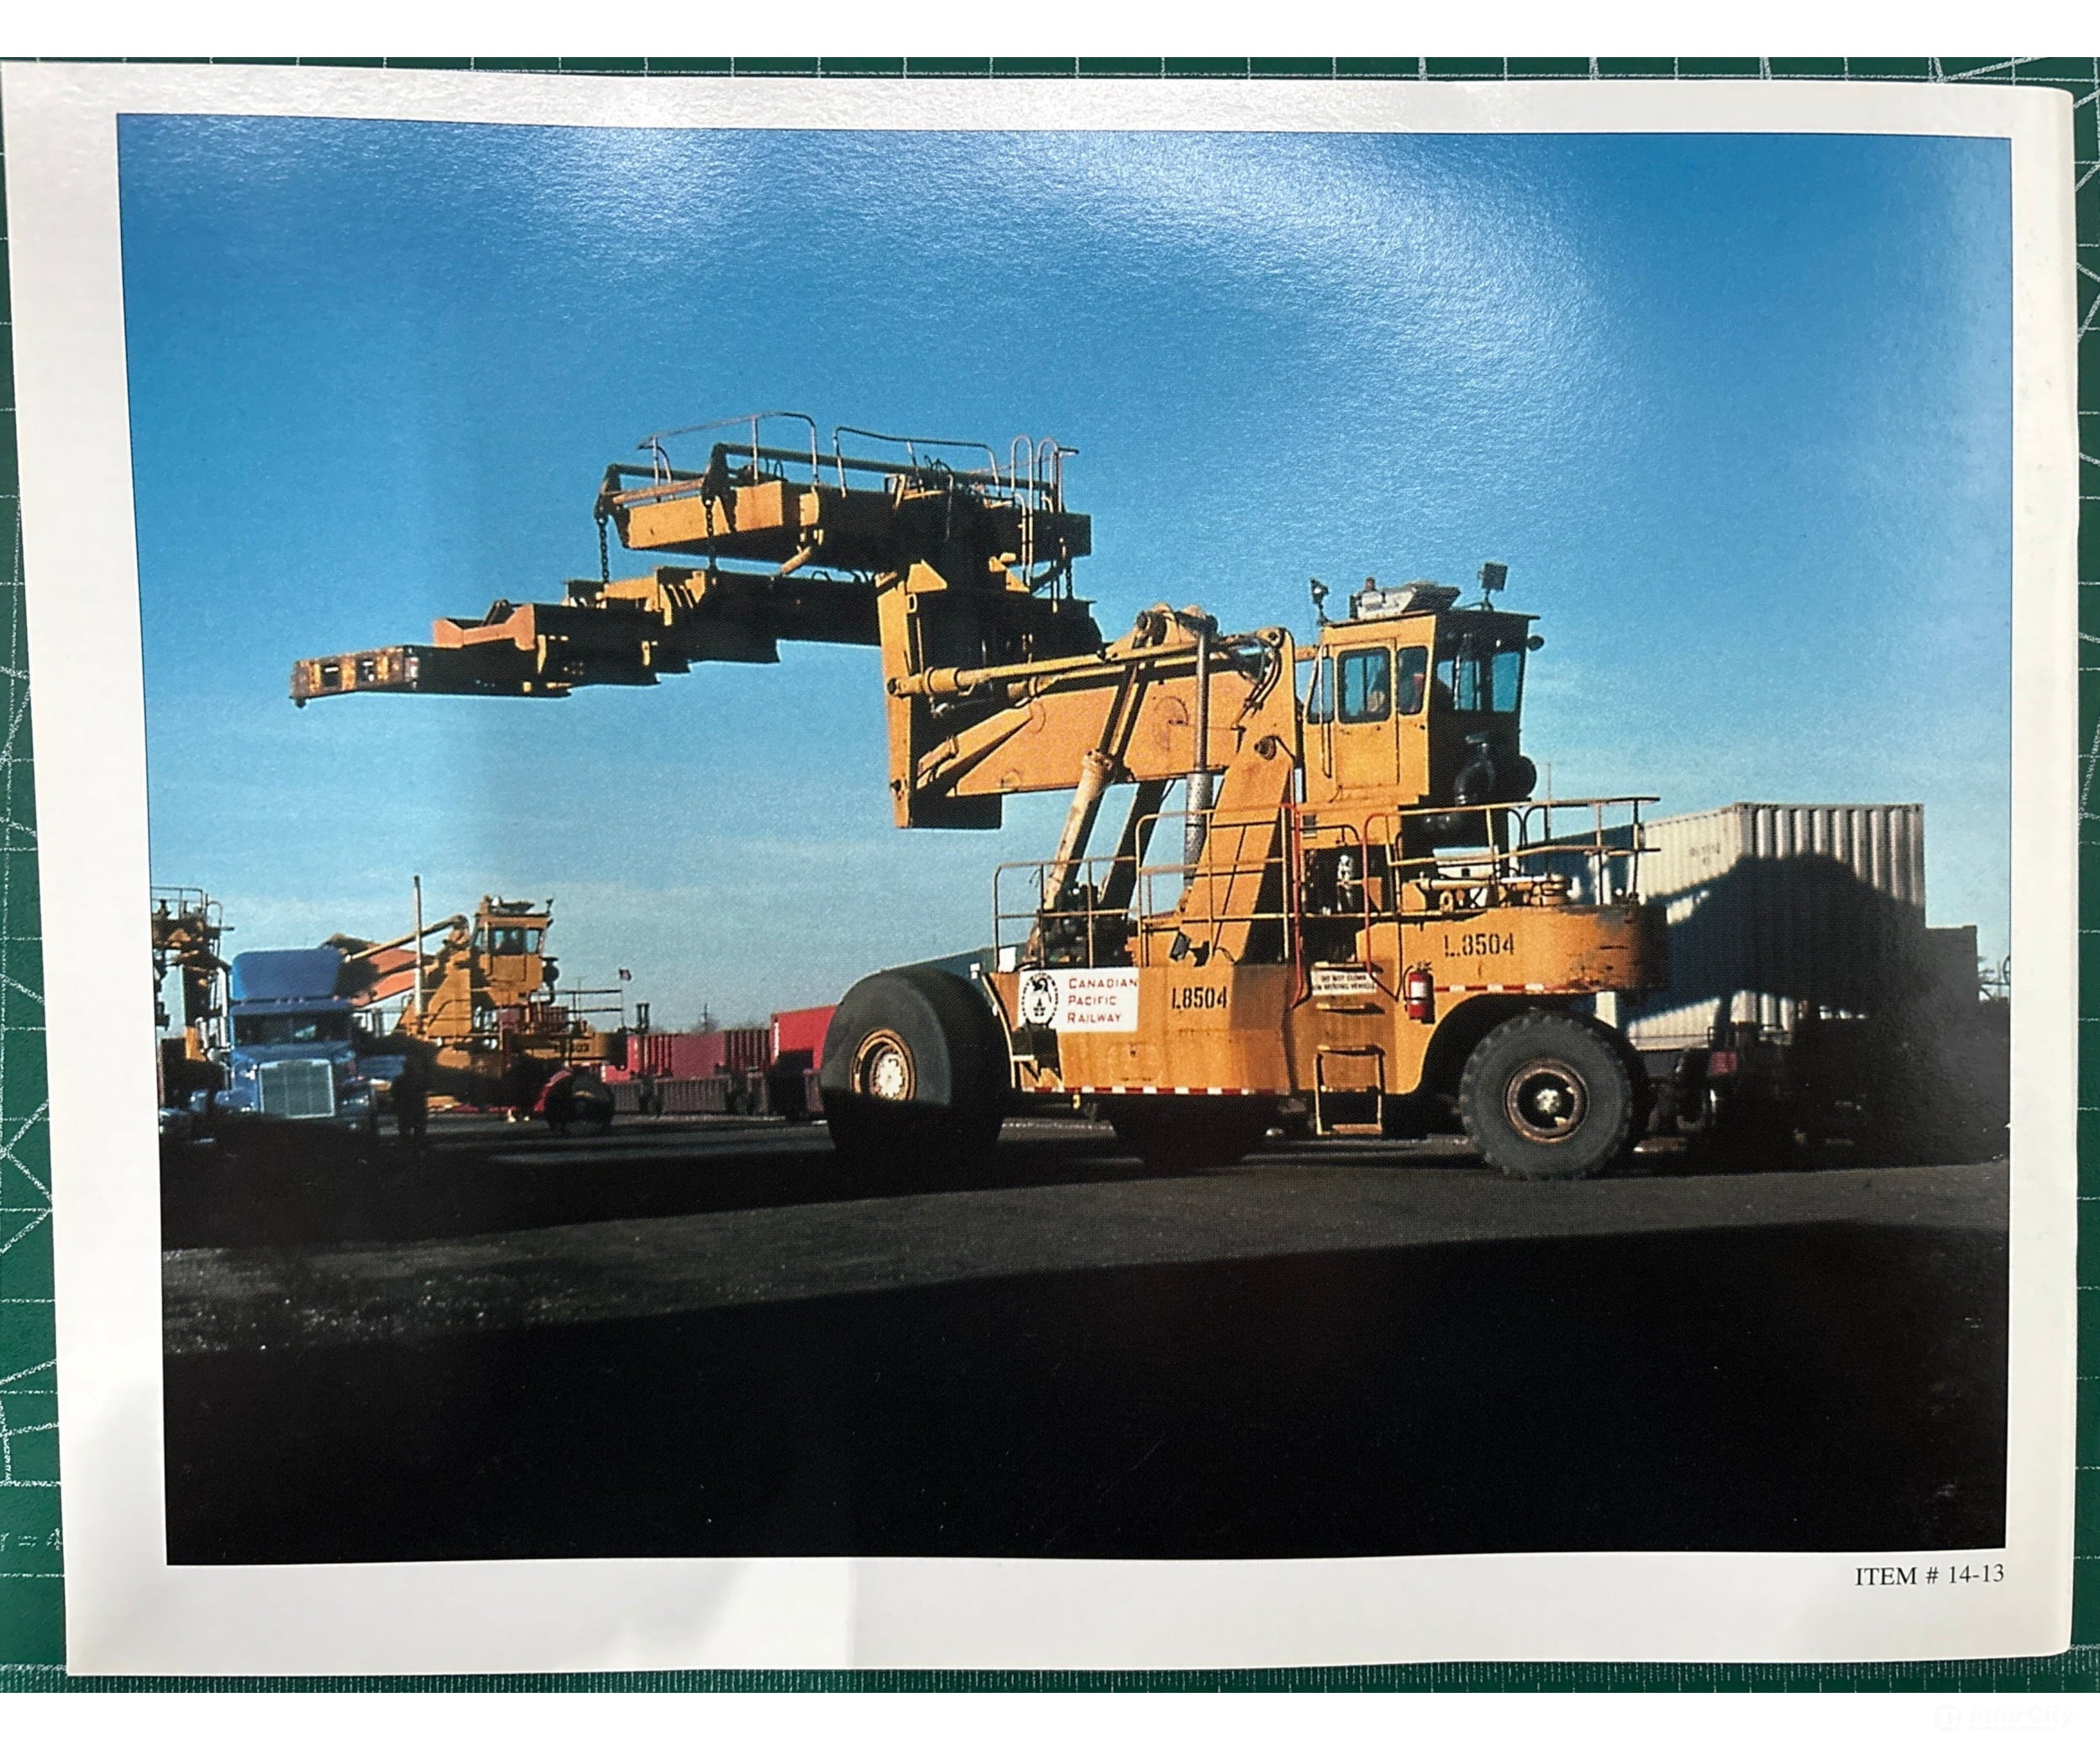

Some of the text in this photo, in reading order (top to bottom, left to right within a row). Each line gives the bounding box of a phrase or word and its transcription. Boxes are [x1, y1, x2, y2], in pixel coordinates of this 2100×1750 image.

[1068, 977, 1137, 988] CANADIAN
[1068, 995, 1117, 1006] PACIFIC
[1172, 986, 1228, 1009] L8504
[1067, 1012, 1121, 1023] RAILWAY
[1855, 1563, 2004, 1586] ITEM # 14-13
